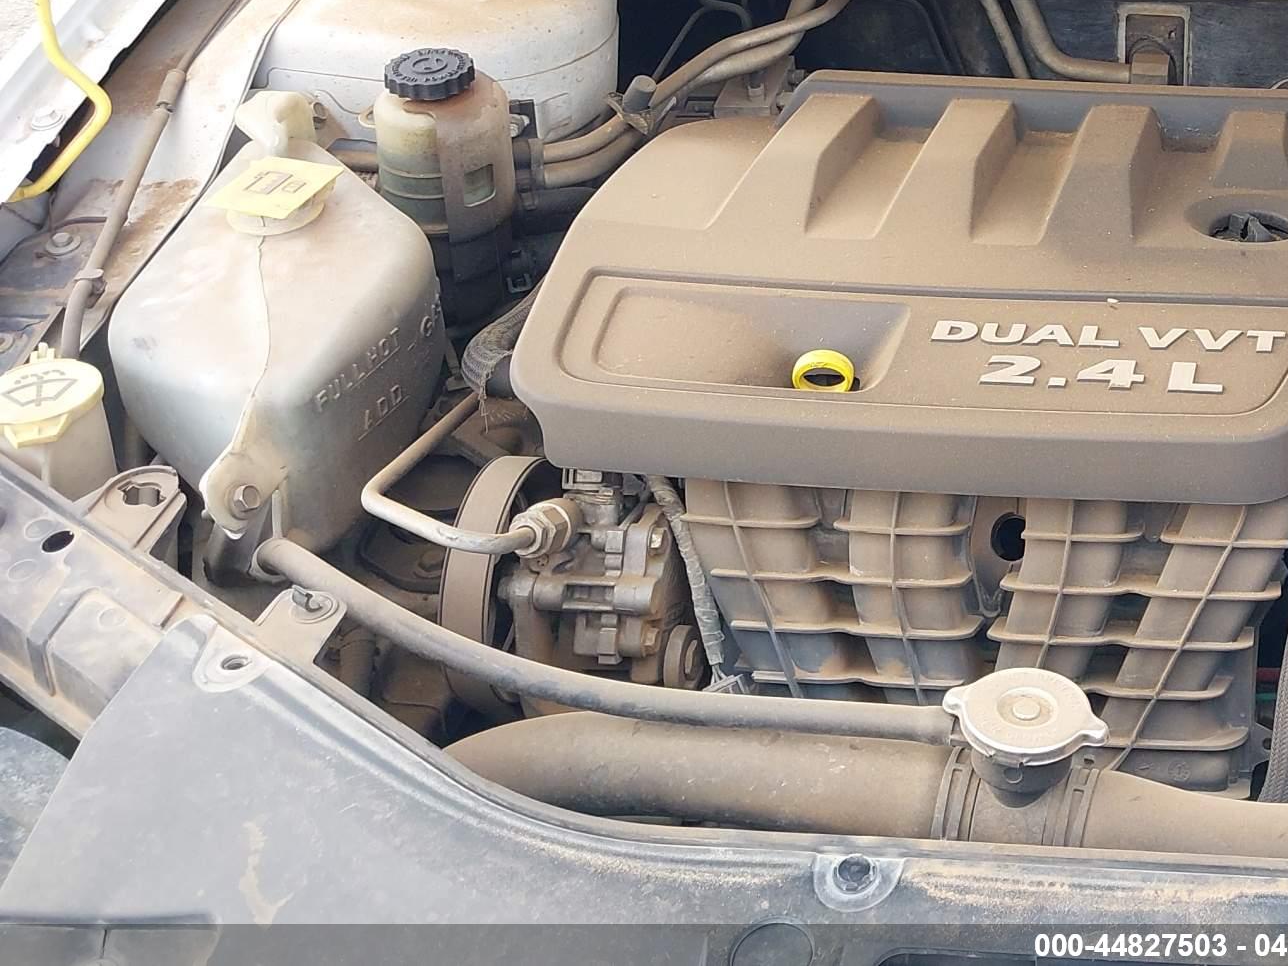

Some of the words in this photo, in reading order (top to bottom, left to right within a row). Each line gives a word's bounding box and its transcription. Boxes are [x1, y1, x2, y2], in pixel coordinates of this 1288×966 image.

[930, 320, 1121, 347] DUAL
[1138, 326, 1287, 353] VVT
[977, 355, 1146, 391] 2.4
[1166, 361, 1225, 394] L
